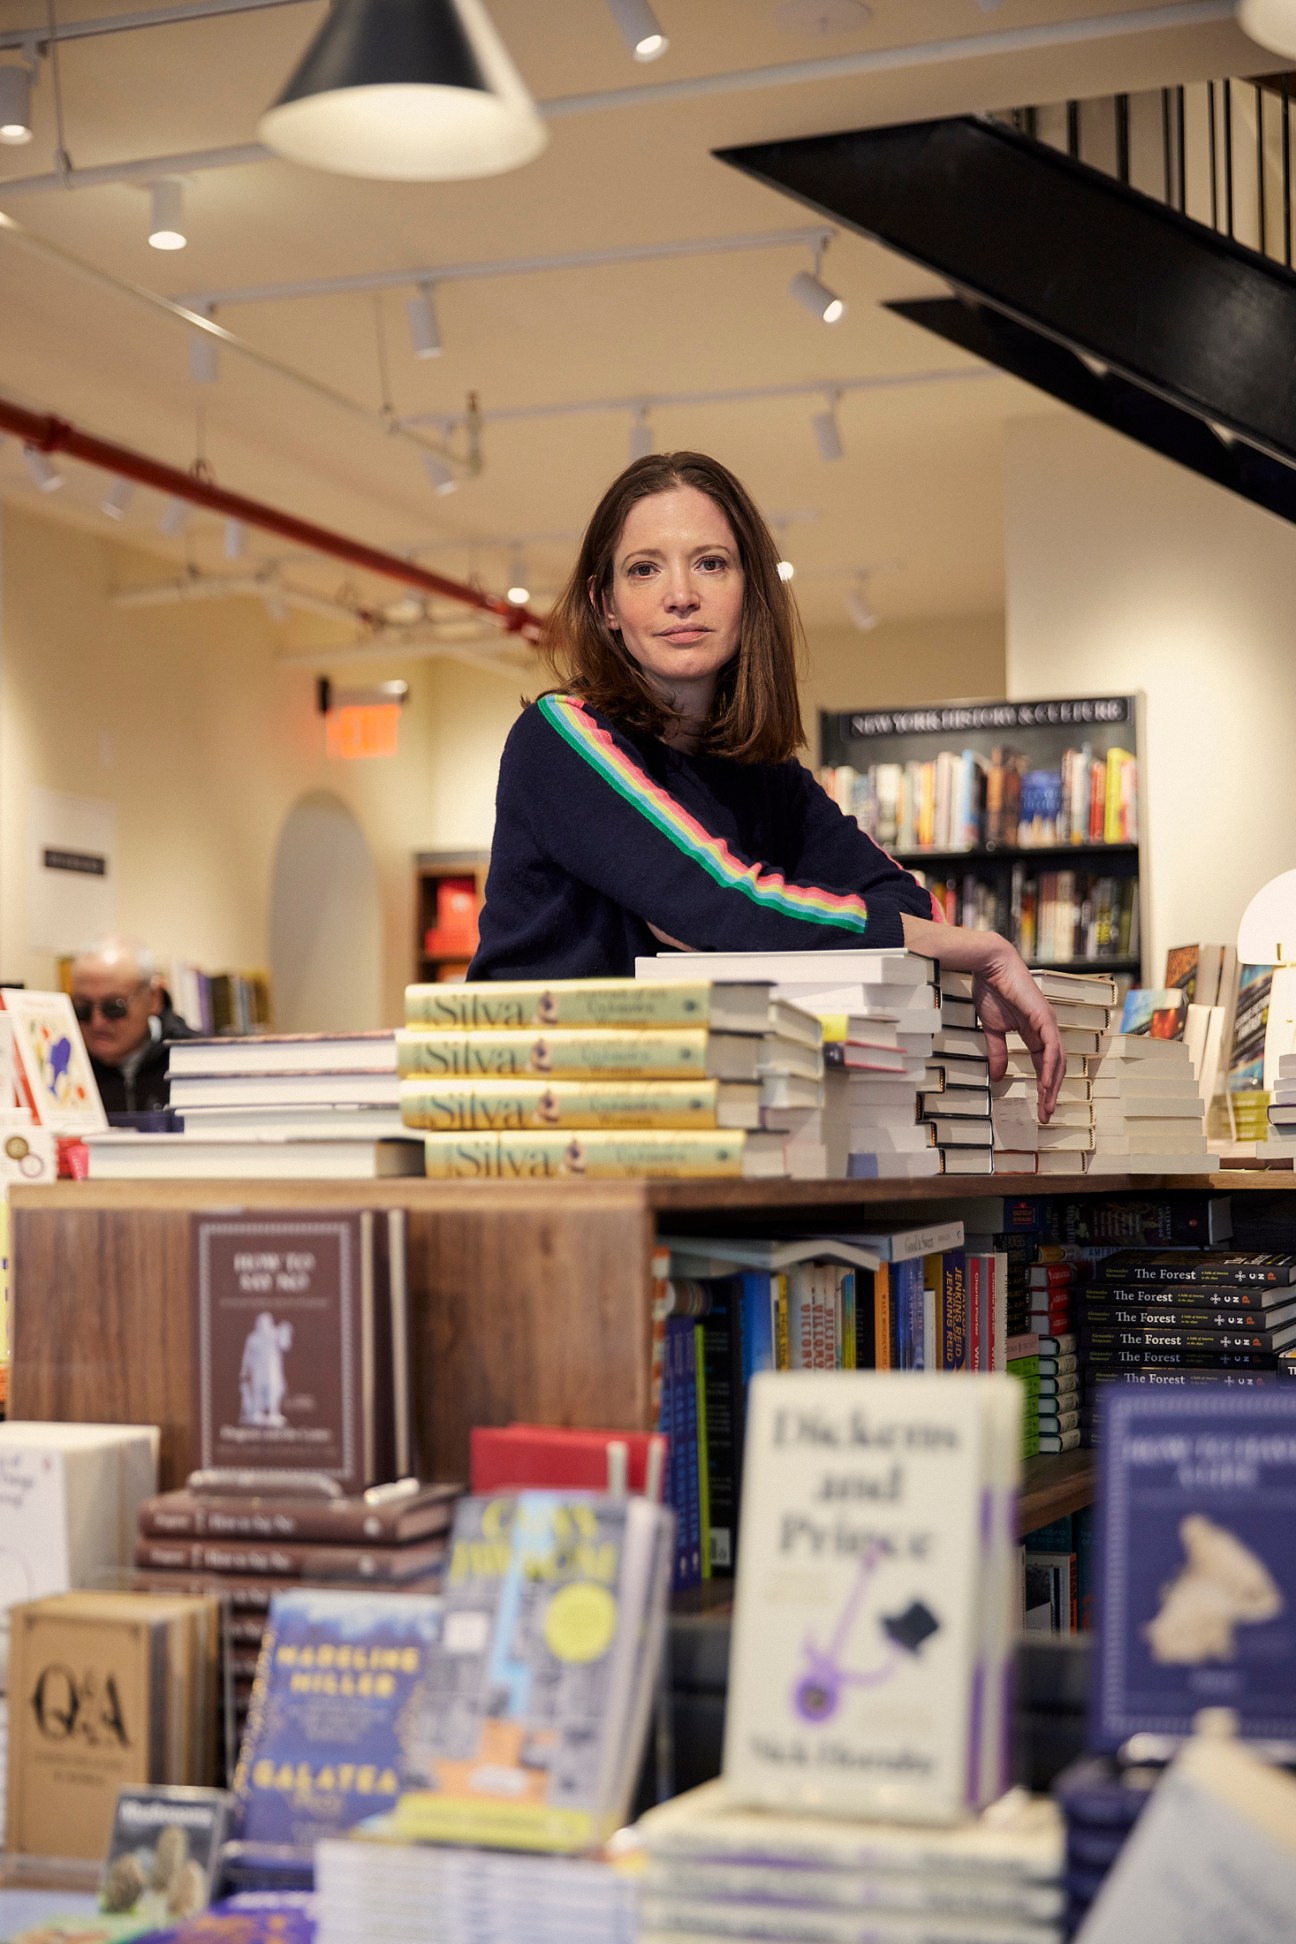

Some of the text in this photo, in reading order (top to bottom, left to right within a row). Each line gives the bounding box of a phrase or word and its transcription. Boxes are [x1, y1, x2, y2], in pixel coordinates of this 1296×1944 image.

[853, 713, 892, 736] NEW
[893, 711, 941, 733] YORK
[942, 706, 1017, 731] HISTORY
[1035, 699, 1126, 725] CULTURE
[434, 994, 524, 1027] Silva
[423, 1042, 518, 1075] Silva
[430, 1092, 527, 1129] Silva
[455, 1140, 551, 1177] Silva
[1134, 1268, 1197, 1280] The Forest
[1113, 1290, 1173, 1302] The Forest
[1115, 1311, 1176, 1324] The Forest
[1119, 1333, 1182, 1345] The Forest
[1118, 1351, 1140, 1362] The
[1143, 1352, 1181, 1363] Forest
[1123, 1373, 1145, 1384] The
[1149, 1373, 1186, 1385] Forest
[772, 1406, 961, 1453] Dickens
[813, 1464, 904, 1505] and
[779, 1513, 936, 1563] Prince
[290, 1672, 396, 1698] MILLER
[252, 1758, 398, 1796] GALATEA
